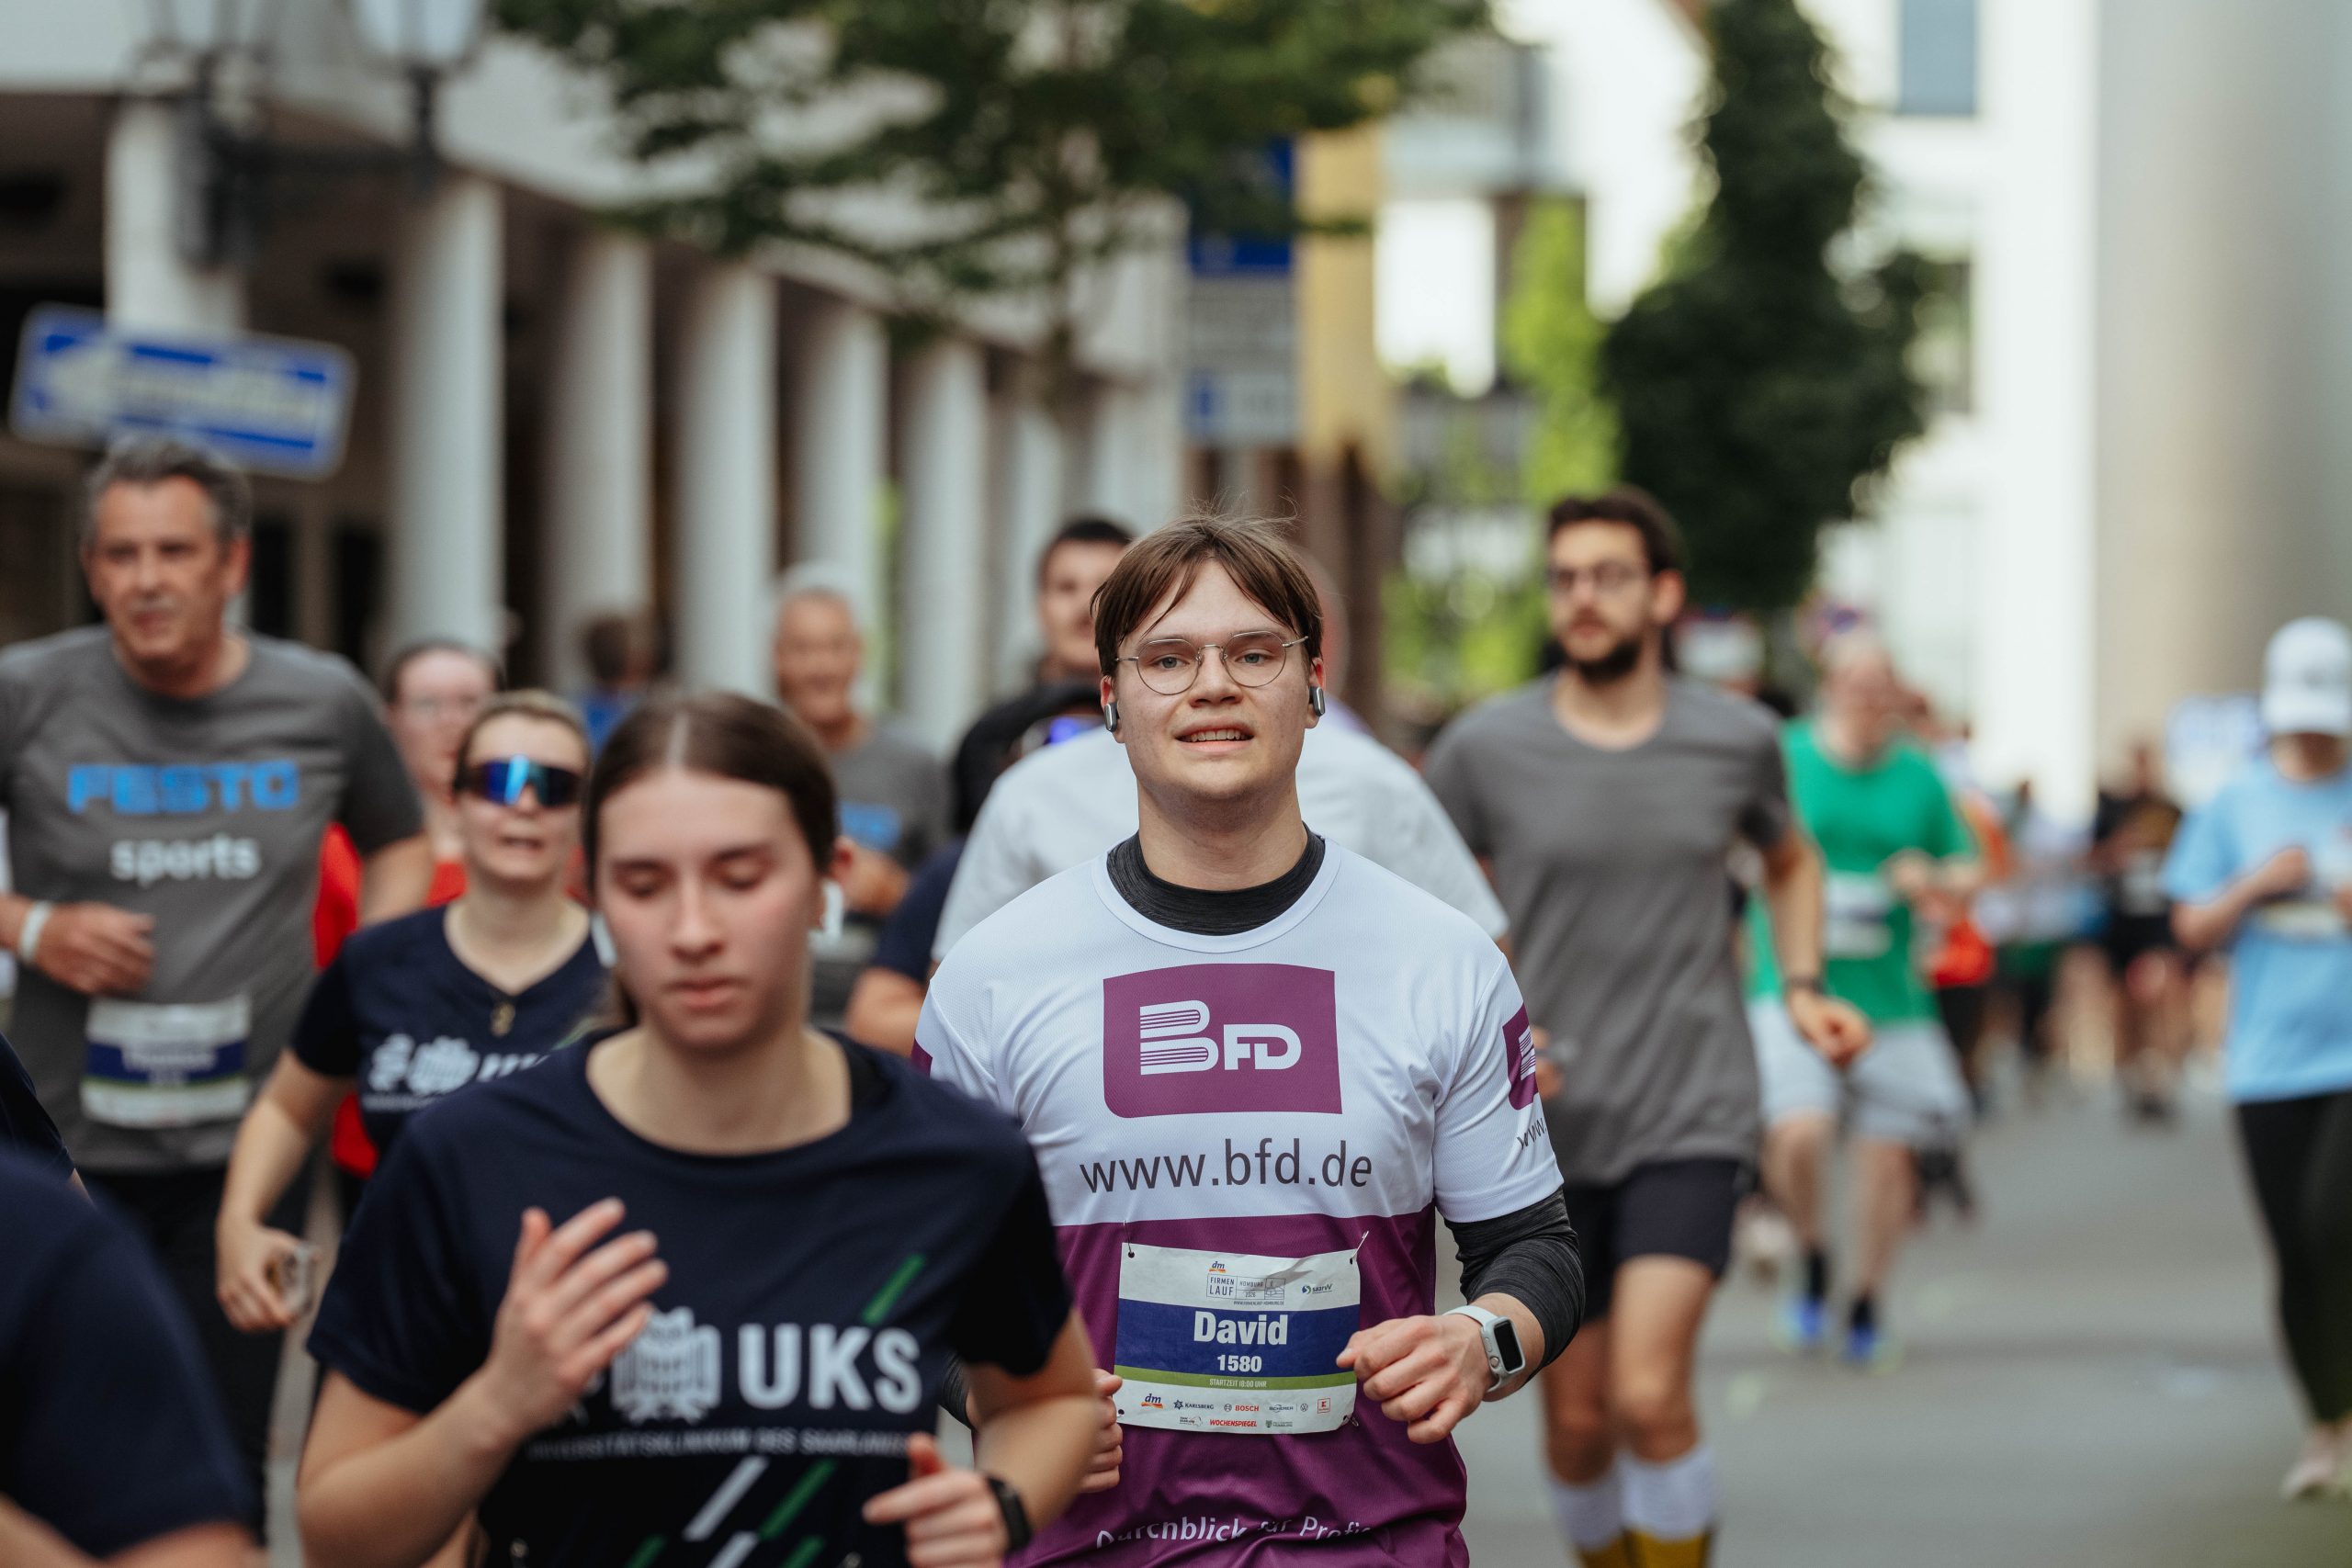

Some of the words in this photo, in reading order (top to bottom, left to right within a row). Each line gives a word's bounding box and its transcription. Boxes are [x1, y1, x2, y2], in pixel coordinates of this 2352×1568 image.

[68, 759, 300, 814] FESTO
[111, 832, 261, 887] sports
[1080, 1137, 1372, 1193] www.bfd.de
[1209, 1285, 1234, 1296] LAUF
[1210, 1277, 1235, 1285] FIRMEN
[1193, 1310, 1288, 1346] David
[738, 1323, 922, 1415] UKS
[1217, 1354, 1262, 1373] 1580
[1209, 1379, 1238, 1387] STARTZEIT
[1238, 1380, 1254, 1388] 18:00
[1145, 1393, 1161, 1404] dm
[1209, 1419, 1258, 1427] WOCHENSPIEGEL
